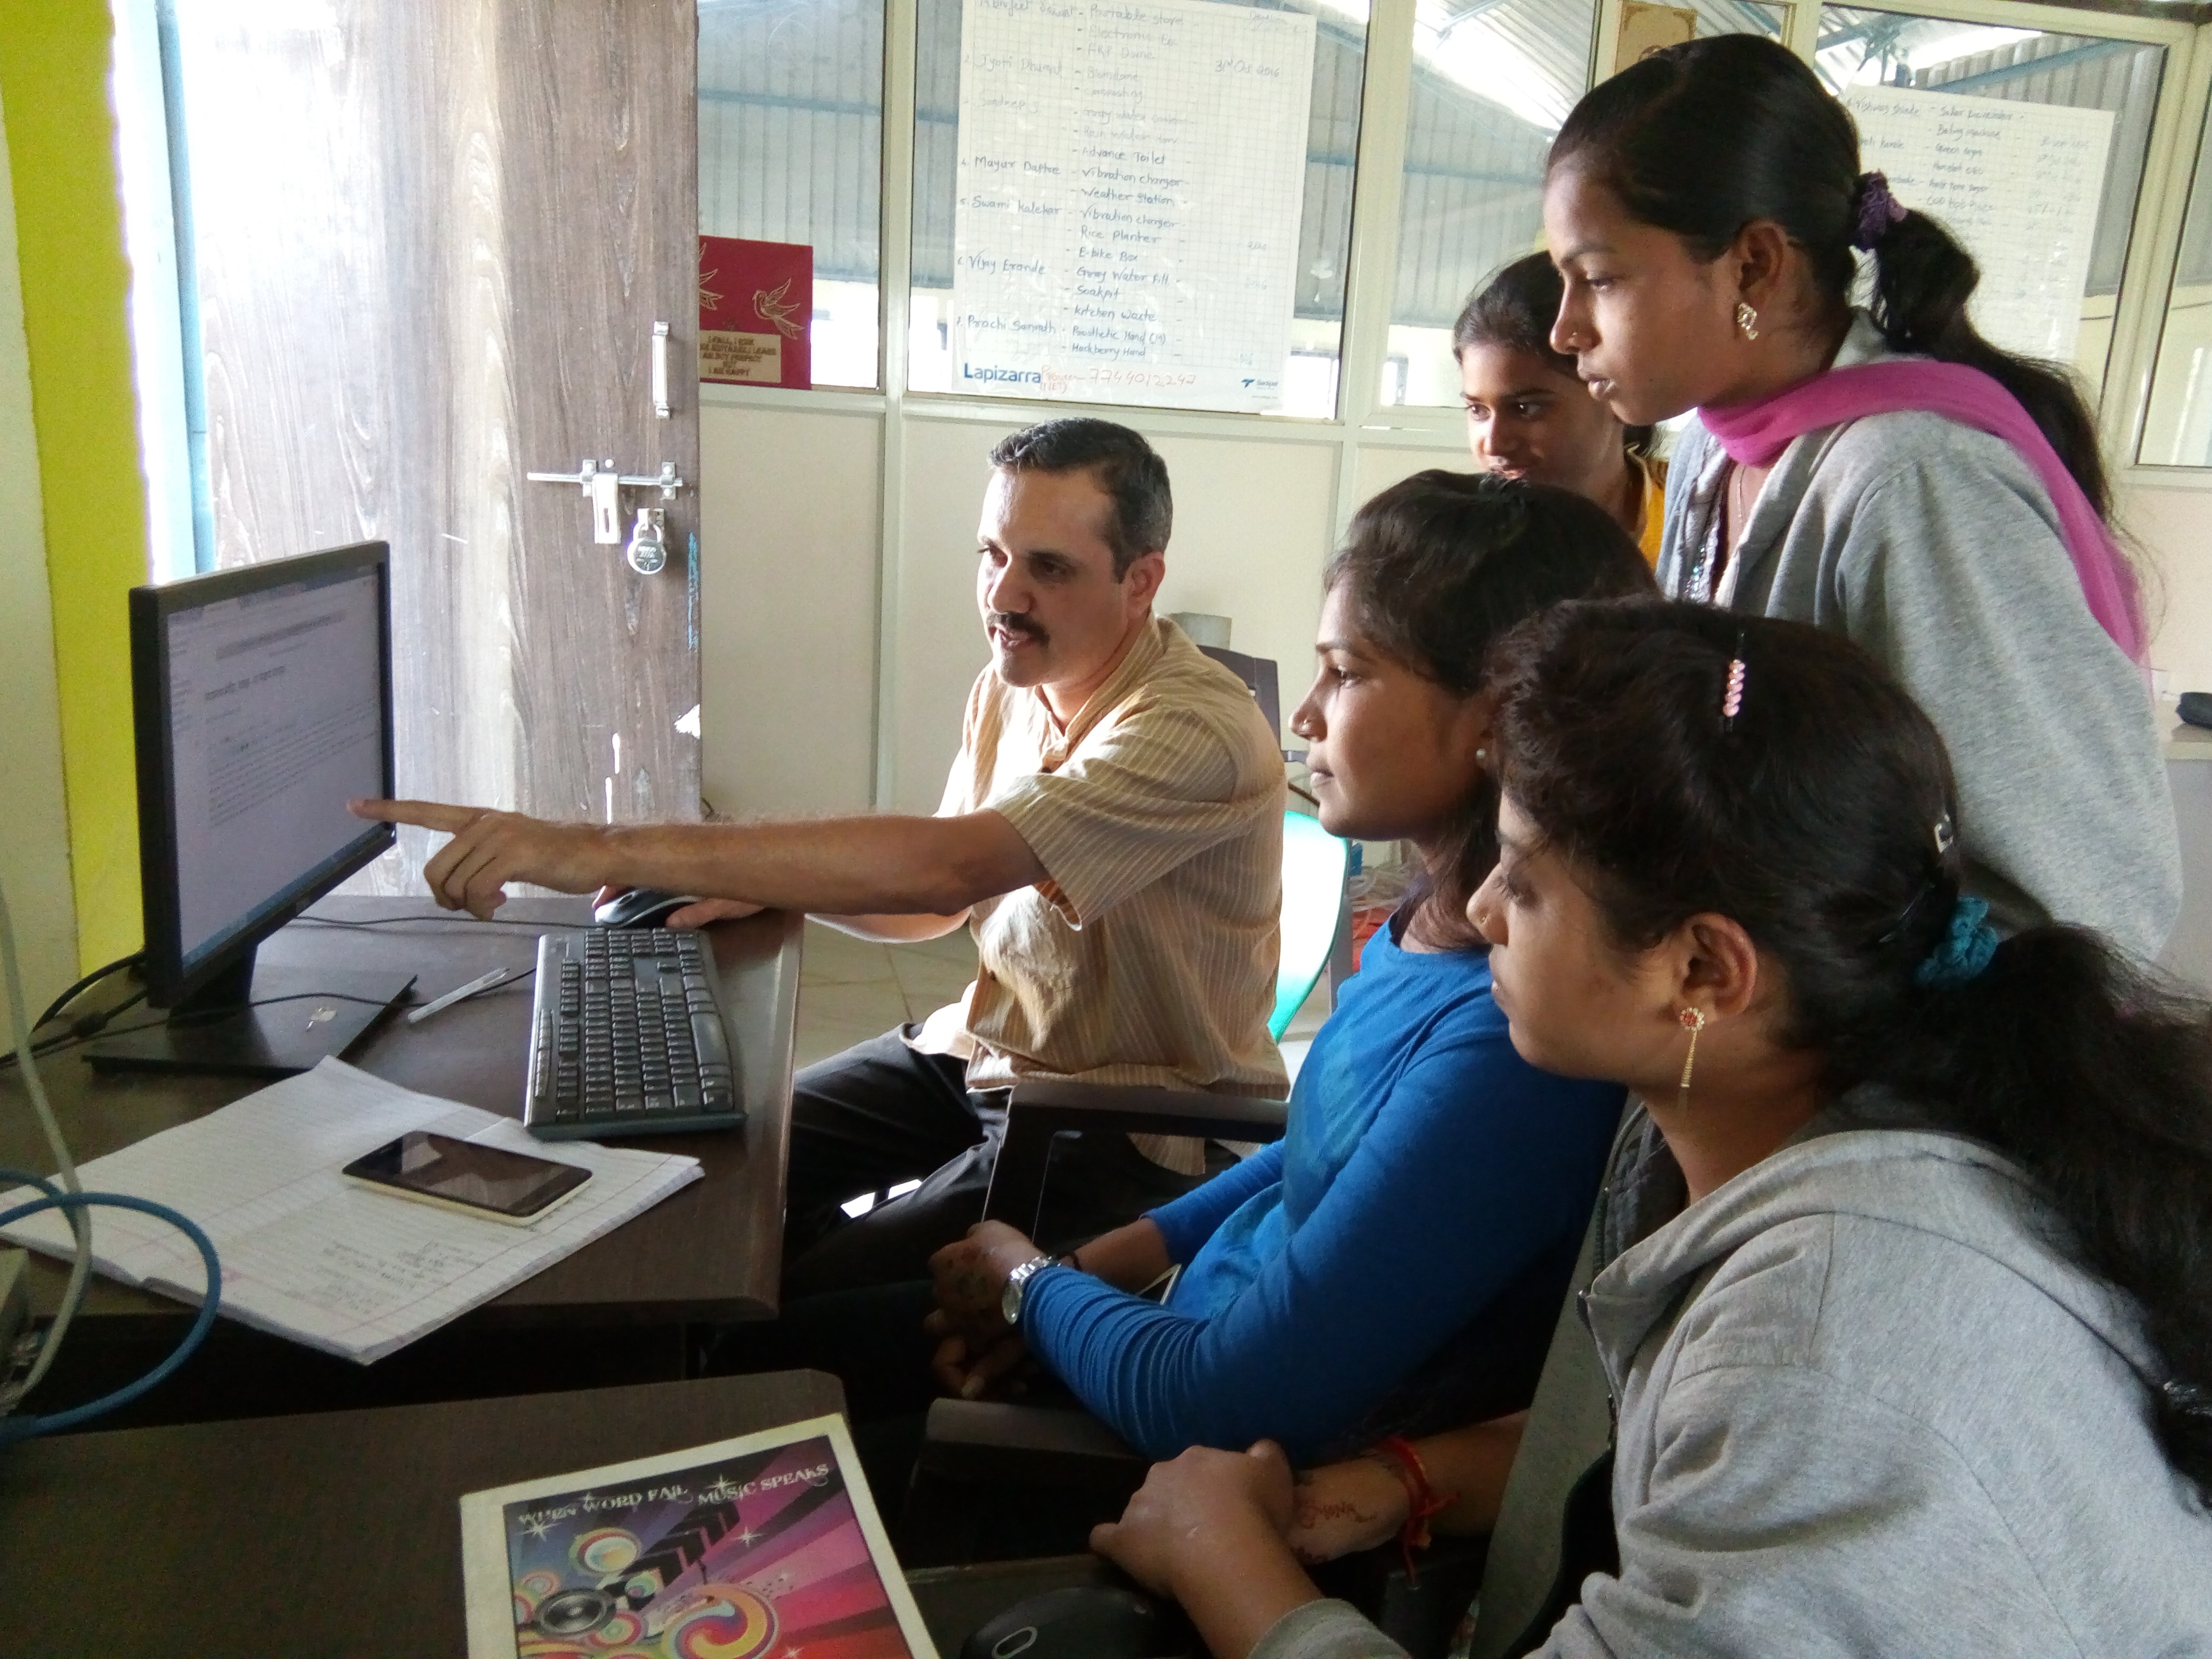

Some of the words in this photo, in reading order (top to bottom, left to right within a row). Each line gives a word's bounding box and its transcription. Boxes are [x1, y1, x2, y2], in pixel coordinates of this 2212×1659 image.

[975, 156, 1017, 171] Mayur
[1134, 150, 1166, 165] Toilet
[1082, 167, 1136, 183] Vibration
[971, 195, 1009, 209] Swami
[1079, 203, 1133, 223] Vibration
[1081, 225, 1104, 239] Rice
[1124, 331, 1147, 344] Hand
[1122, 346, 1146, 357] Hand
[963, 362, 1041, 384] Lapizarra
[583, 1493, 643, 1512] WORD
[698, 1481, 757, 1506] MUSIC
[760, 1464, 829, 1491] SPEAKS
